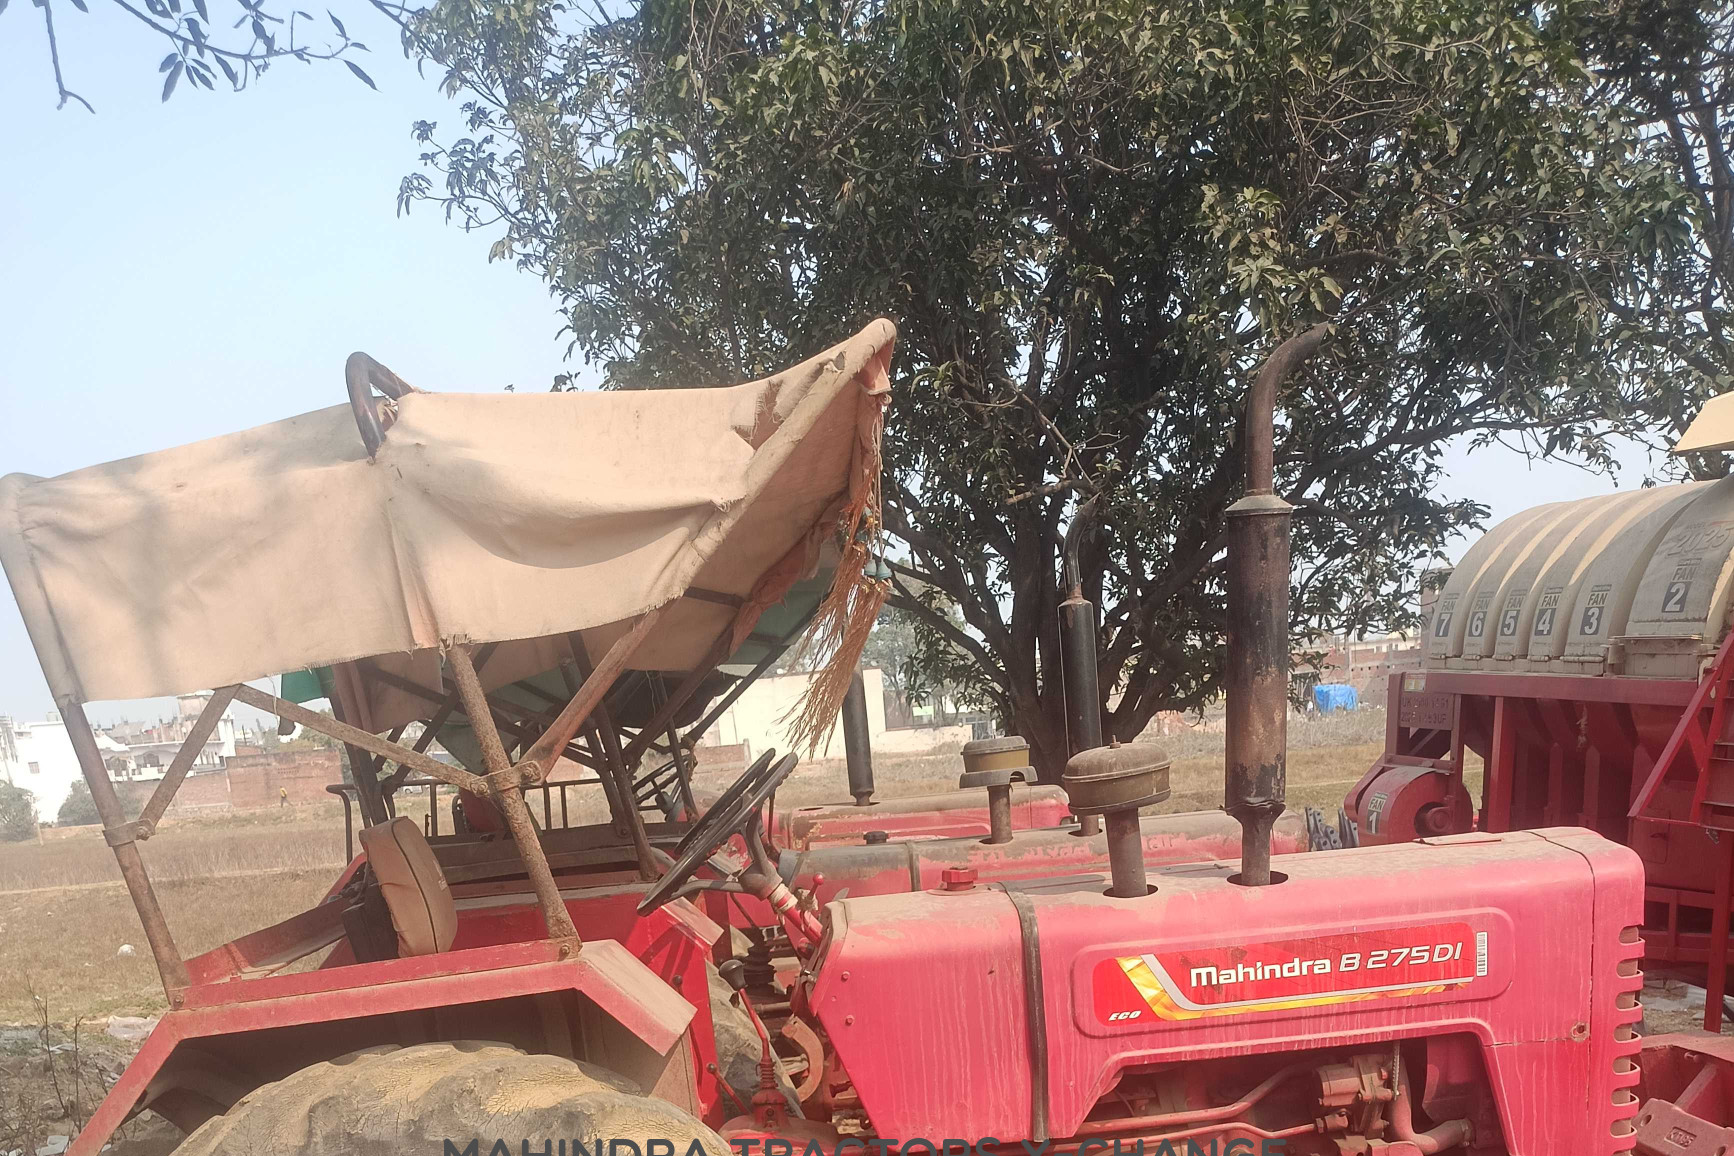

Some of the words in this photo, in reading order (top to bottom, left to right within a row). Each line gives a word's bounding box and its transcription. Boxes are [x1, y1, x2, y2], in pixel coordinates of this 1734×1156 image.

[1672, 567, 1697, 581] FAN
[1506, 597, 1523, 608] FAN
[1541, 595, 1560, 607] FAN
[1587, 593, 1608, 605] FAN
[1664, 582, 1686, 612] 2
[1438, 613, 1451, 636] 7
[1471, 612, 1484, 636] 6
[1503, 610, 1518, 635] 5
[1537, 609, 1552, 634] 4
[1584, 607, 1600, 634] 3
[1369, 798, 1385, 810] FAN
[1369, 811, 1378, 834] 1
[1189, 957, 1331, 987] Mahindra
[1339, 953, 1360, 972] B
[1107, 1010, 1141, 1021] ECO
